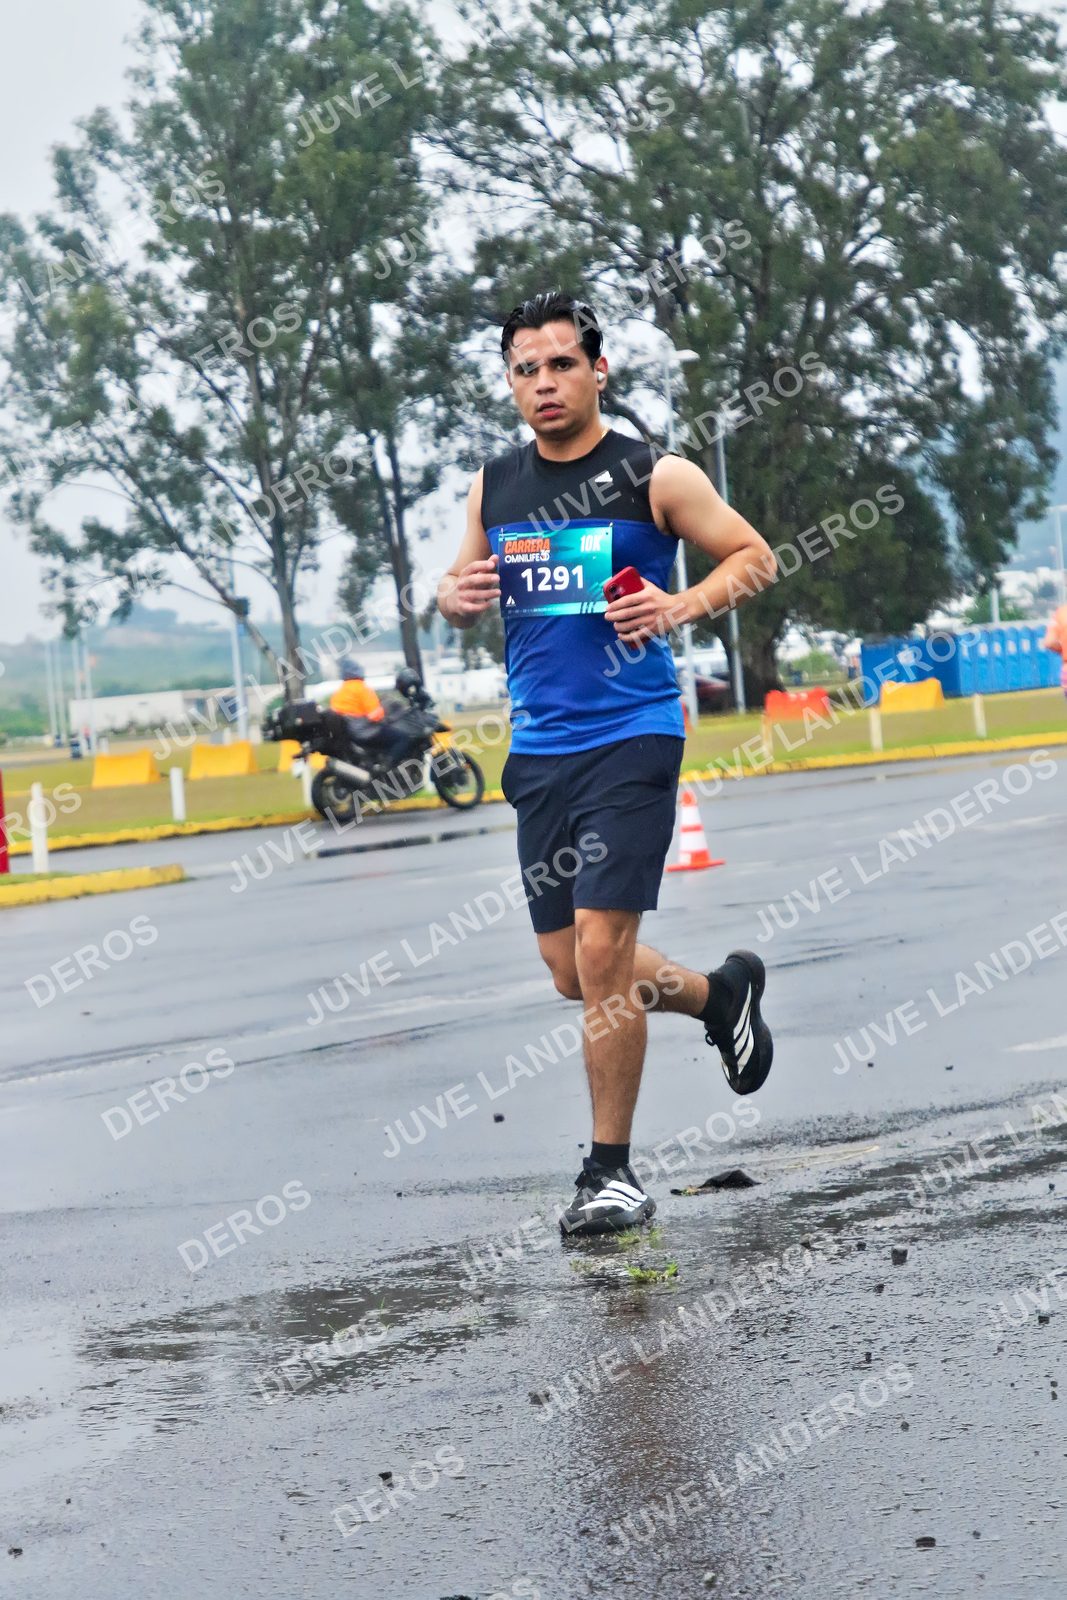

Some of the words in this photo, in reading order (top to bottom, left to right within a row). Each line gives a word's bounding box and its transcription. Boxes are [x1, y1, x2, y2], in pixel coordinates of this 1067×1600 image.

[504, 537, 550, 554] CARRERA
[580, 534, 601, 551] 10K
[504, 552, 541, 564] OMNILIFE
[521, 565, 583, 592] 1291
